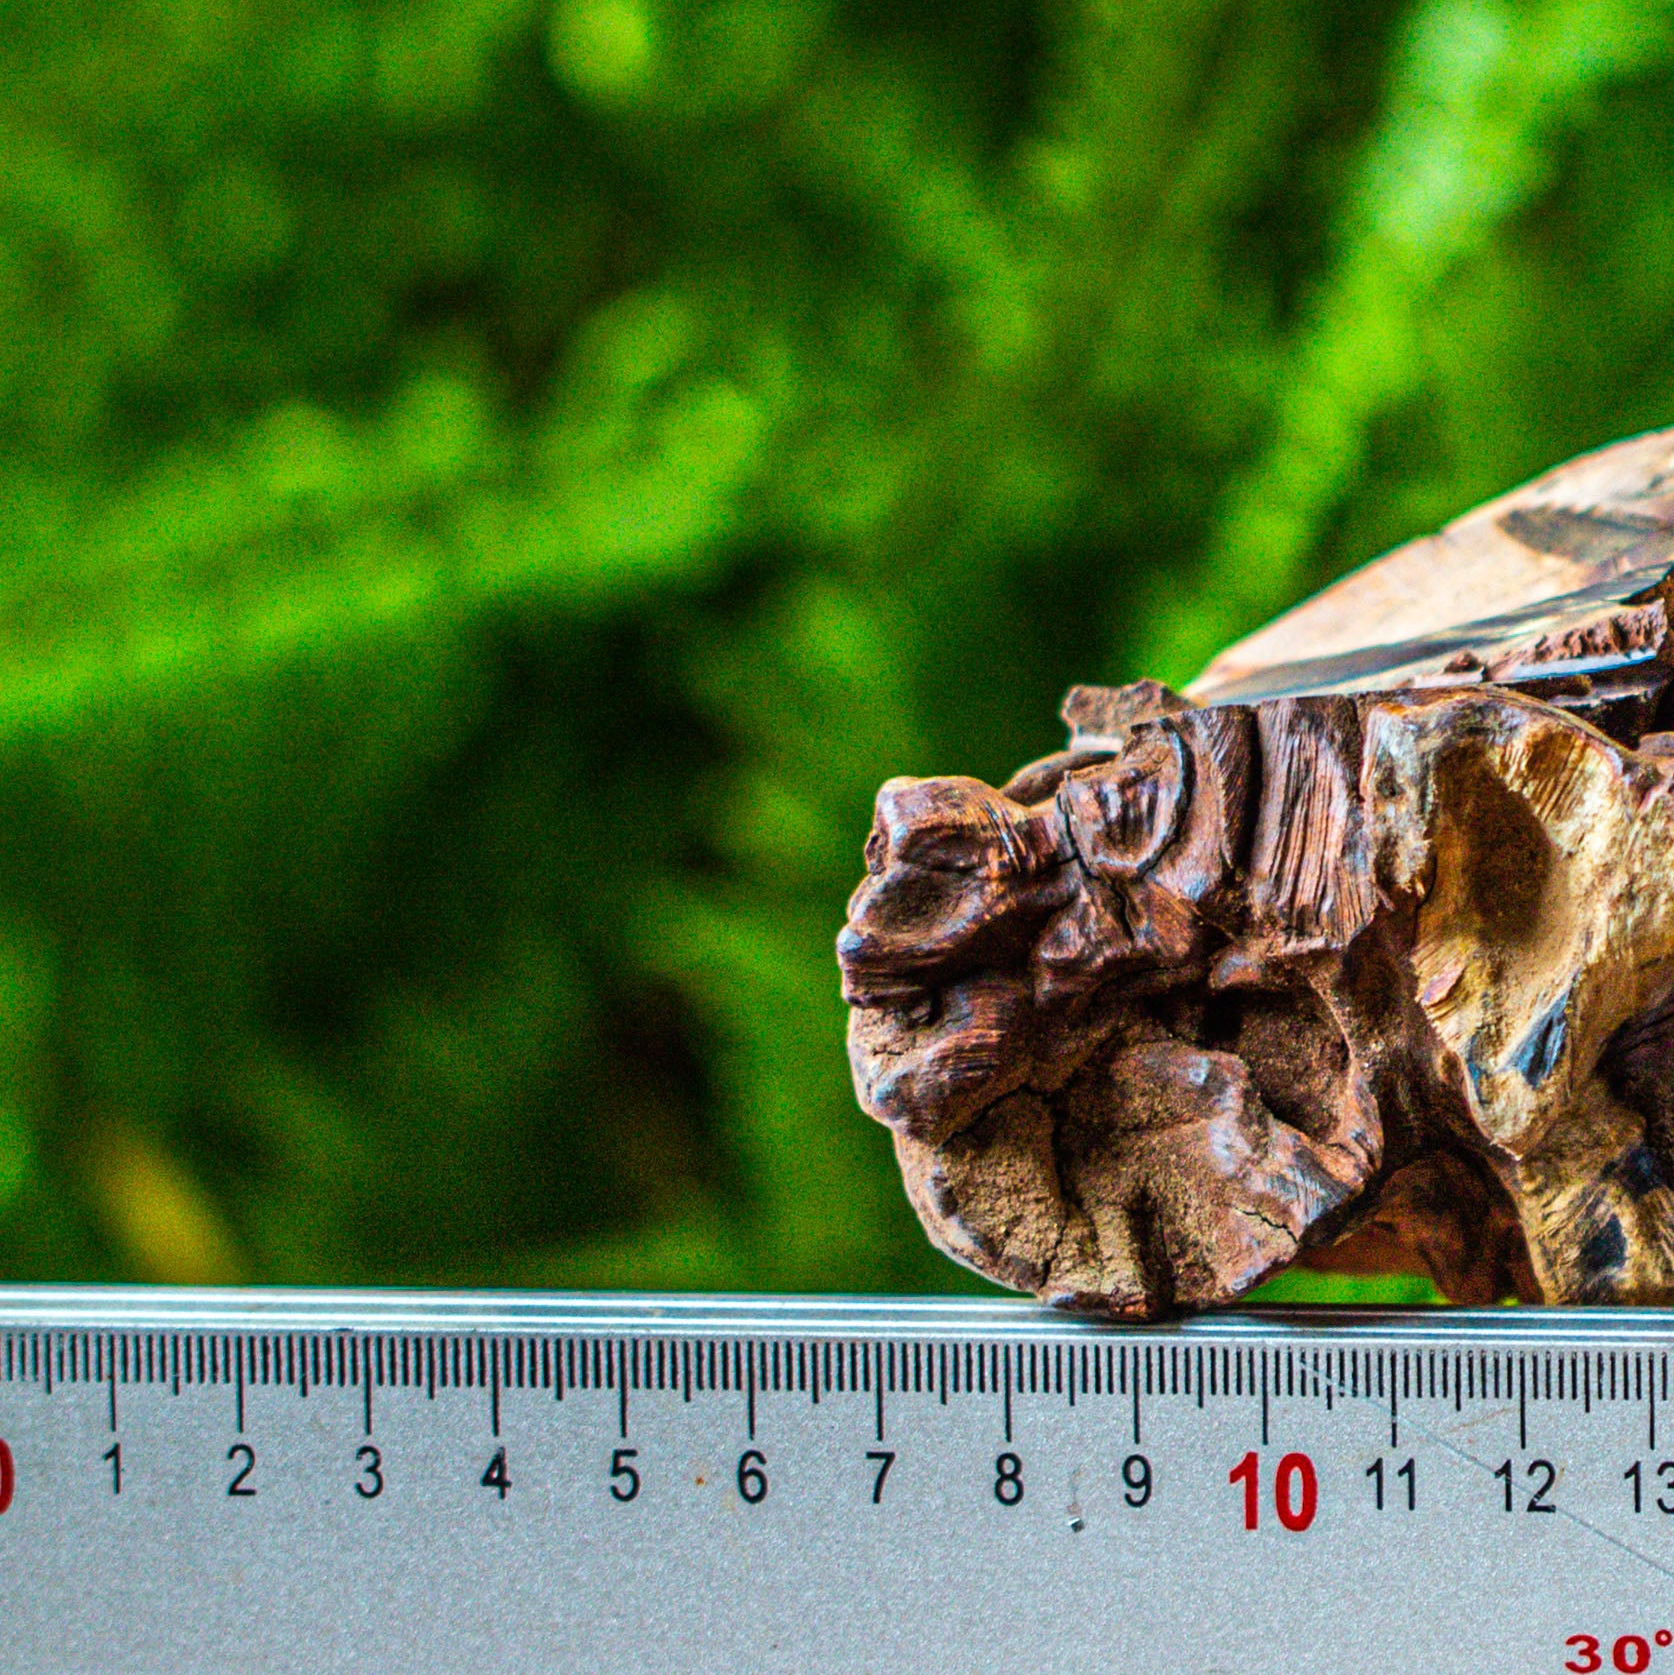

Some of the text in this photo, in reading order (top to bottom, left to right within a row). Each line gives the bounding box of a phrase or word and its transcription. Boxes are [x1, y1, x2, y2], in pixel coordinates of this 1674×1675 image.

[103, 1442, 122, 1495] 1
[227, 1443, 257, 1497] 2
[355, 1445, 384, 1499] 3
[481, 1446, 512, 1500] 4
[610, 1448, 641, 1503] 5
[737, 1449, 768, 1505] 6
[866, 1451, 896, 1504] 7
[994, 1452, 1024, 1506] 8
[1122, 1454, 1152, 1508] 9
[1229, 1451, 1318, 1532] 10
[1365, 1457, 1416, 1511] 11
[1494, 1459, 1557, 1513] 12
[1564, 1629, 1673, 1675] 30°
